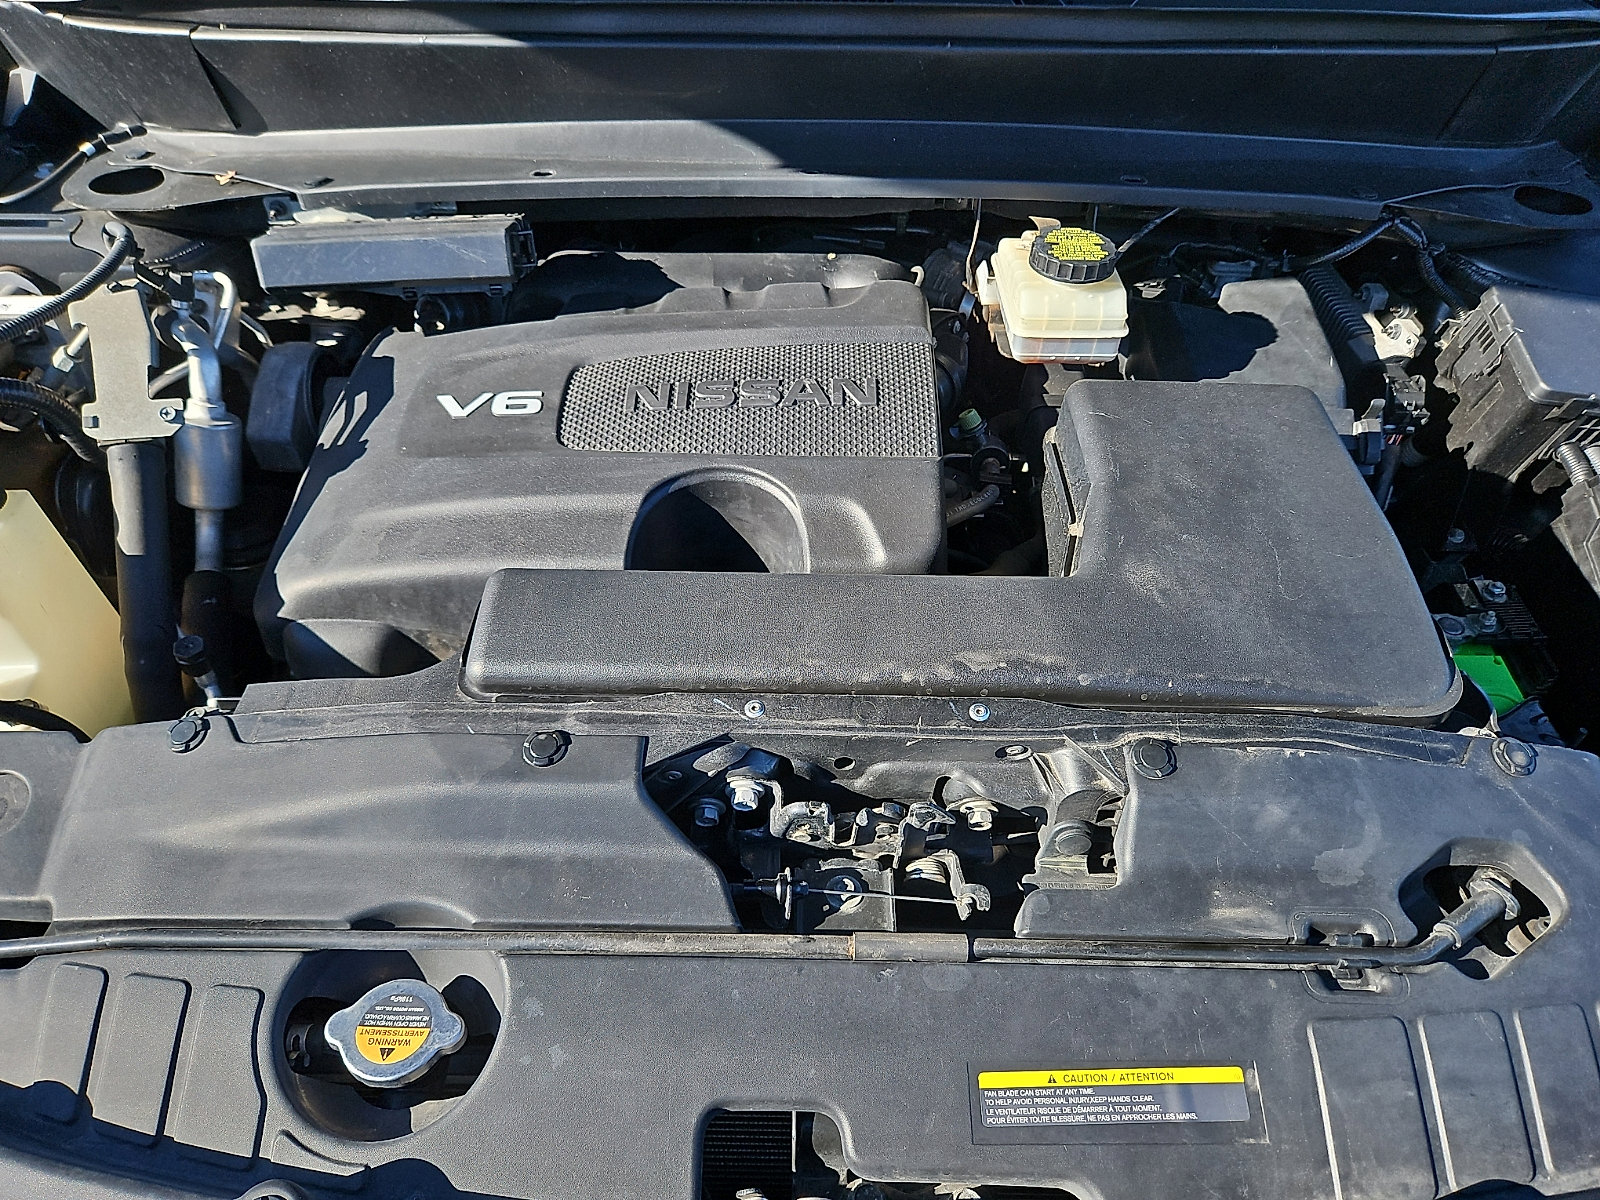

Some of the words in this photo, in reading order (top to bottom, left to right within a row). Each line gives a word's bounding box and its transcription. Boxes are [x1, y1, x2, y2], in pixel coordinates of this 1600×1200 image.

[625, 378, 878, 412] NISSAN
[436, 390, 544, 420] V6
[359, 1028, 425, 1037] AVERTISSEMENT
[367, 1037, 411, 1047] WARNING
[1063, 1073, 1108, 1083] CAUTION
[1120, 1072, 1174, 1082] ATTENTION
[984, 1090, 997, 1098] FAN
[998, 1089, 1020, 1097] BLADE
[1020, 1089, 1034, 1097] CAN
[1056, 1088, 1064, 1096] AT
[1078, 1087, 1096, 1095] TIME.
[1034, 1096, 1068, 1104] PERSONAL
[1108, 1095, 1130, 1103] HANDS
[994, 1108, 1036, 1116] VENTILATEUR
[1037, 1106, 1062, 1114] RISQUE
[1072, 1104, 1108, 1114] DÉMARRER
[1108, 1104, 1114, 1112] À
[1132, 1104, 1162, 1112] MOMENT.
[986, 1116, 1006, 1124] POUR
[1006, 1114, 1028, 1124] ÉVITER
[1051, 1114, 1087, 1123] BLESSURE,
[1088, 1114, 1097, 1122] NE
